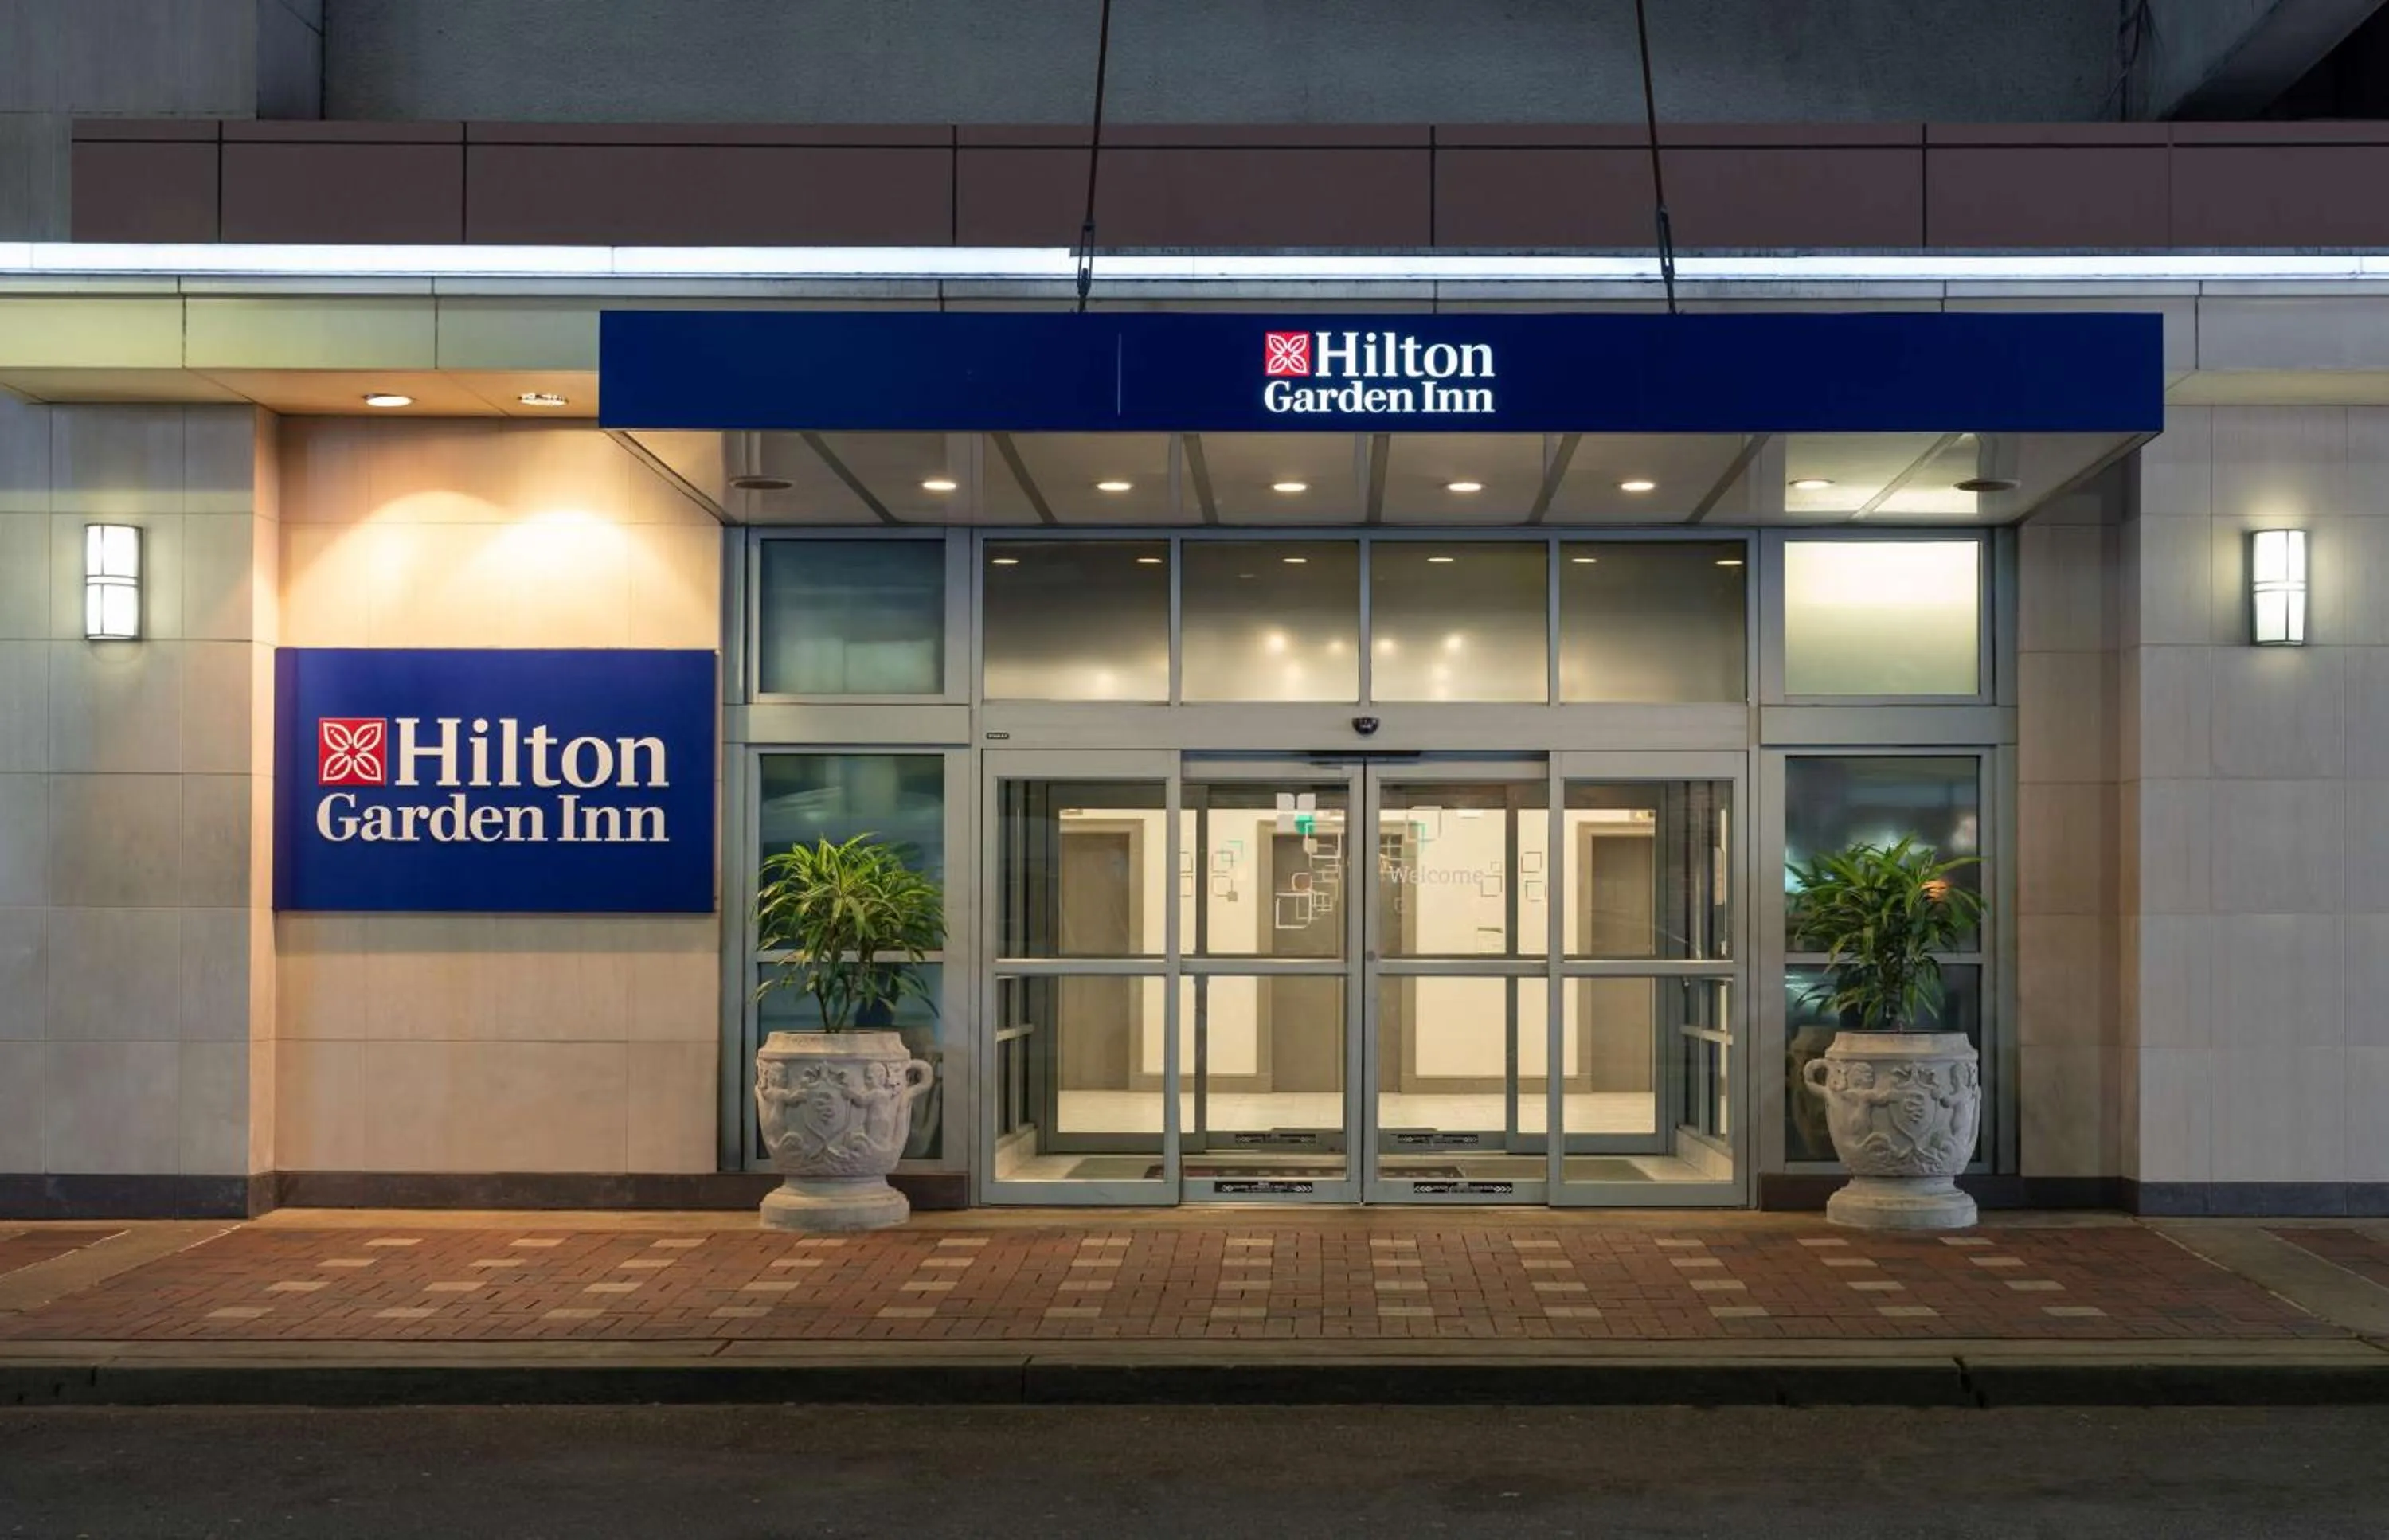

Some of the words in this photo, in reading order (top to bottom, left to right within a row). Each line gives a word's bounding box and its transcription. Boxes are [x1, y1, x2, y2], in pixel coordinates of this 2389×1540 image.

[1315, 331, 1496, 378] Hilton
[1264, 380, 1416, 413] Garden
[1421, 381, 1496, 413] Inn
[394, 717, 670, 788] Hilton
[316, 793, 549, 842] Garden
[557, 794, 670, 842] Inn
[1389, 865, 1484, 885] Welcome
